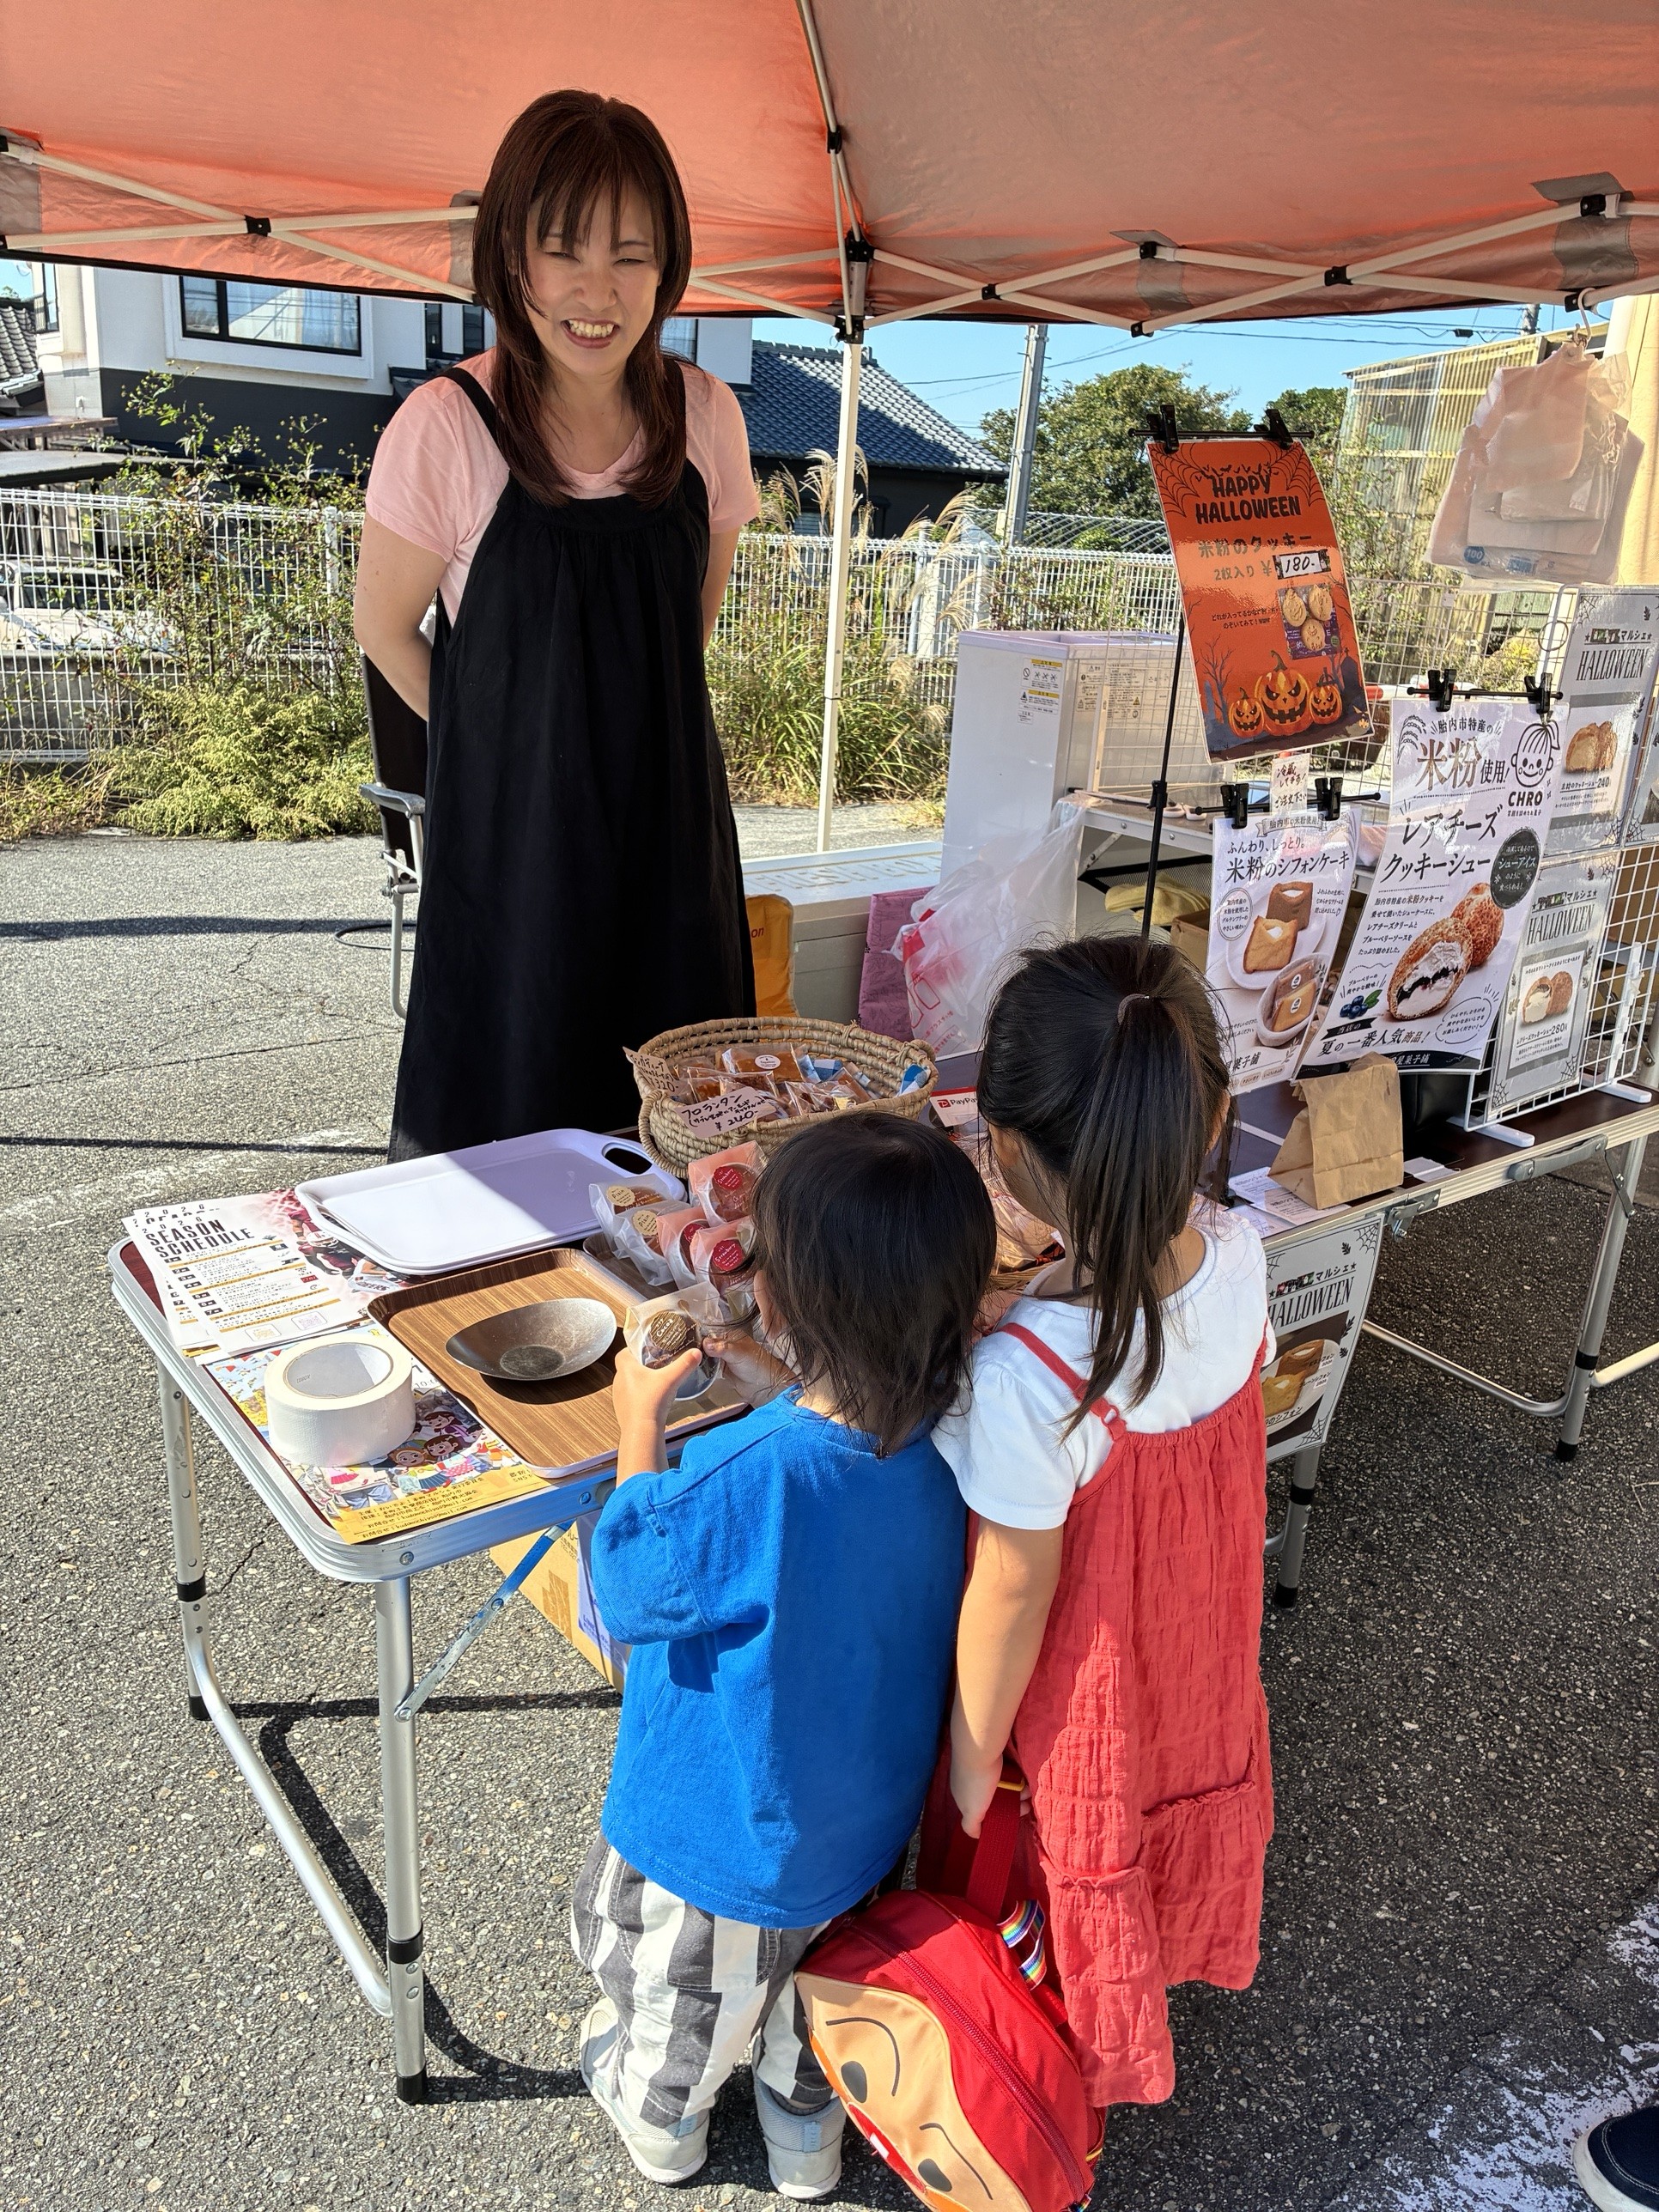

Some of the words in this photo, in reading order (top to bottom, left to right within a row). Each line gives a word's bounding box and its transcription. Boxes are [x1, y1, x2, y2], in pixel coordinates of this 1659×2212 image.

[1212, 473, 1271, 498] HAPPY
[1195, 495, 1302, 525] HALLOWEEN
[1198, 532, 1312, 559] 米粉のクッキー
[1576, 647, 1650, 681] HALLOWEEN
[1437, 716, 1494, 735] 胎内市特産の
[1415, 736, 1483, 792] 米粉
[1508, 790, 1543, 807] CHRO
[1402, 804, 1503, 848] レアチーズ
[1227, 836, 1305, 854] ふんわり、しっとり。
[1224, 851, 1350, 884] 米粉のシフォンケーキ
[1380, 853, 1491, 884] クッキーシュー
[1498, 855, 1536, 870] シューアイス
[1527, 904, 1595, 945] HALLOWEEN
[682, 1095, 742, 1117] フロランタン
[145, 1219, 225, 1246] SEASON
[155, 1228, 255, 1258] SCHEDULE
